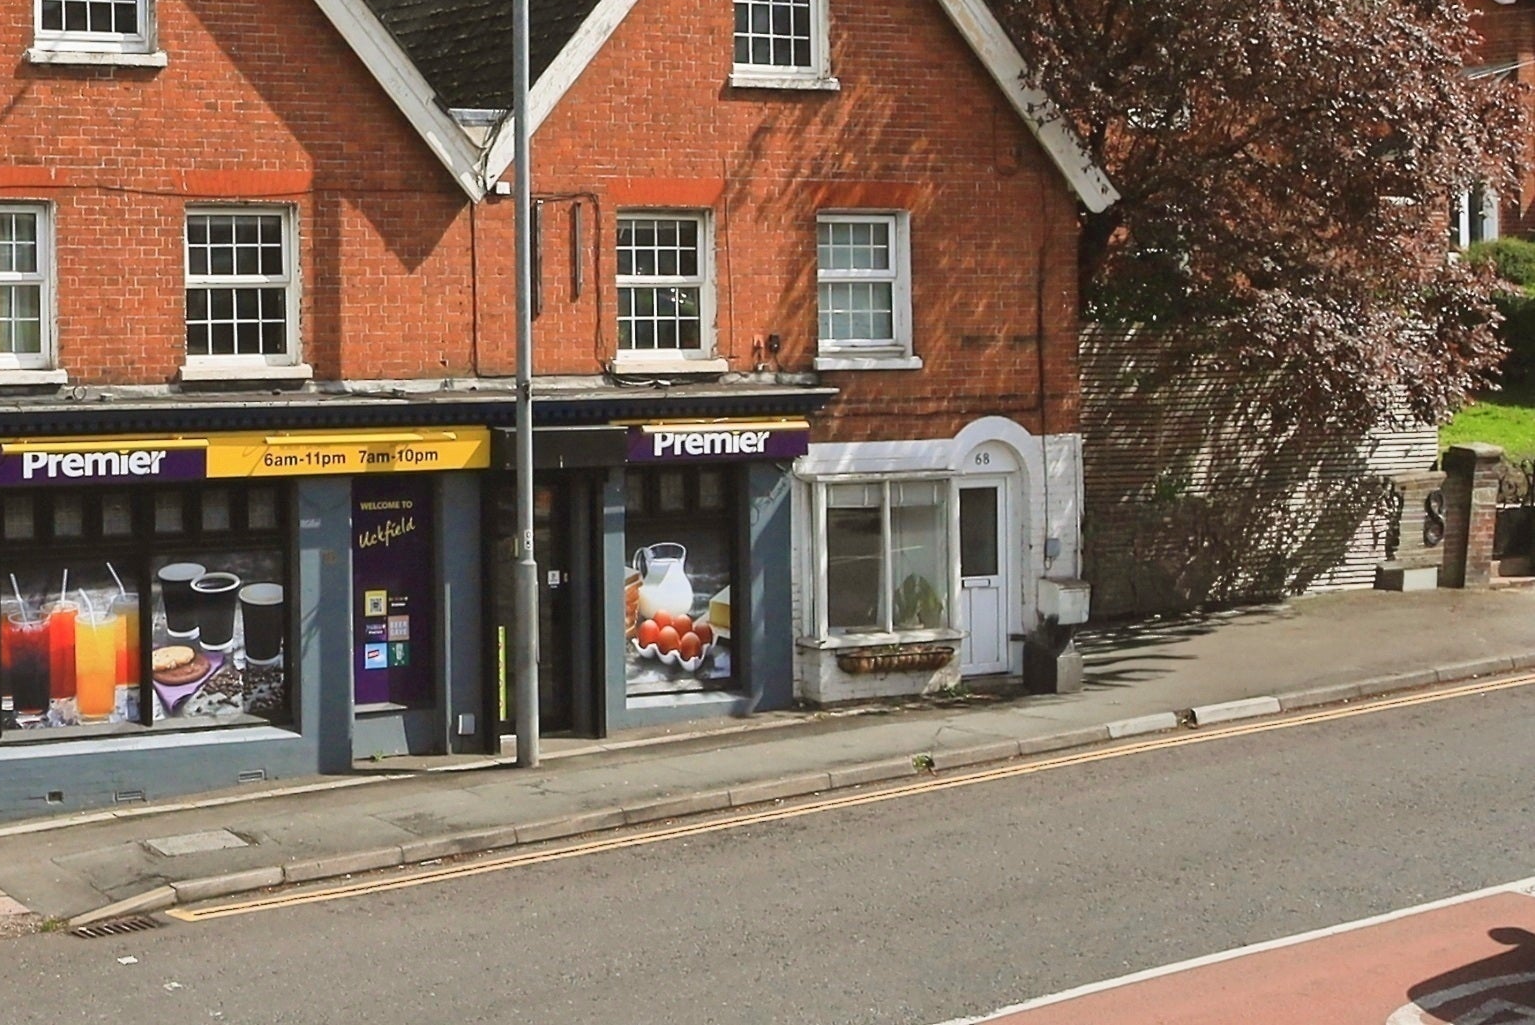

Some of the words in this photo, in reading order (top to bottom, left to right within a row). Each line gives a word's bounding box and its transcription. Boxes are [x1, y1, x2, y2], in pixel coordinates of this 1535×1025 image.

[653, 430, 770, 456] Premier
[23, 449, 167, 479] Premier
[264, 451, 346, 467] 6am-11pm
[358, 449, 439, 464] 7am-10pm
[975, 452, 990, 465] 68
[360, 501, 400, 510] WELCOME
[402, 500, 413, 509] TO
[359, 516, 416, 548] Uckfield
